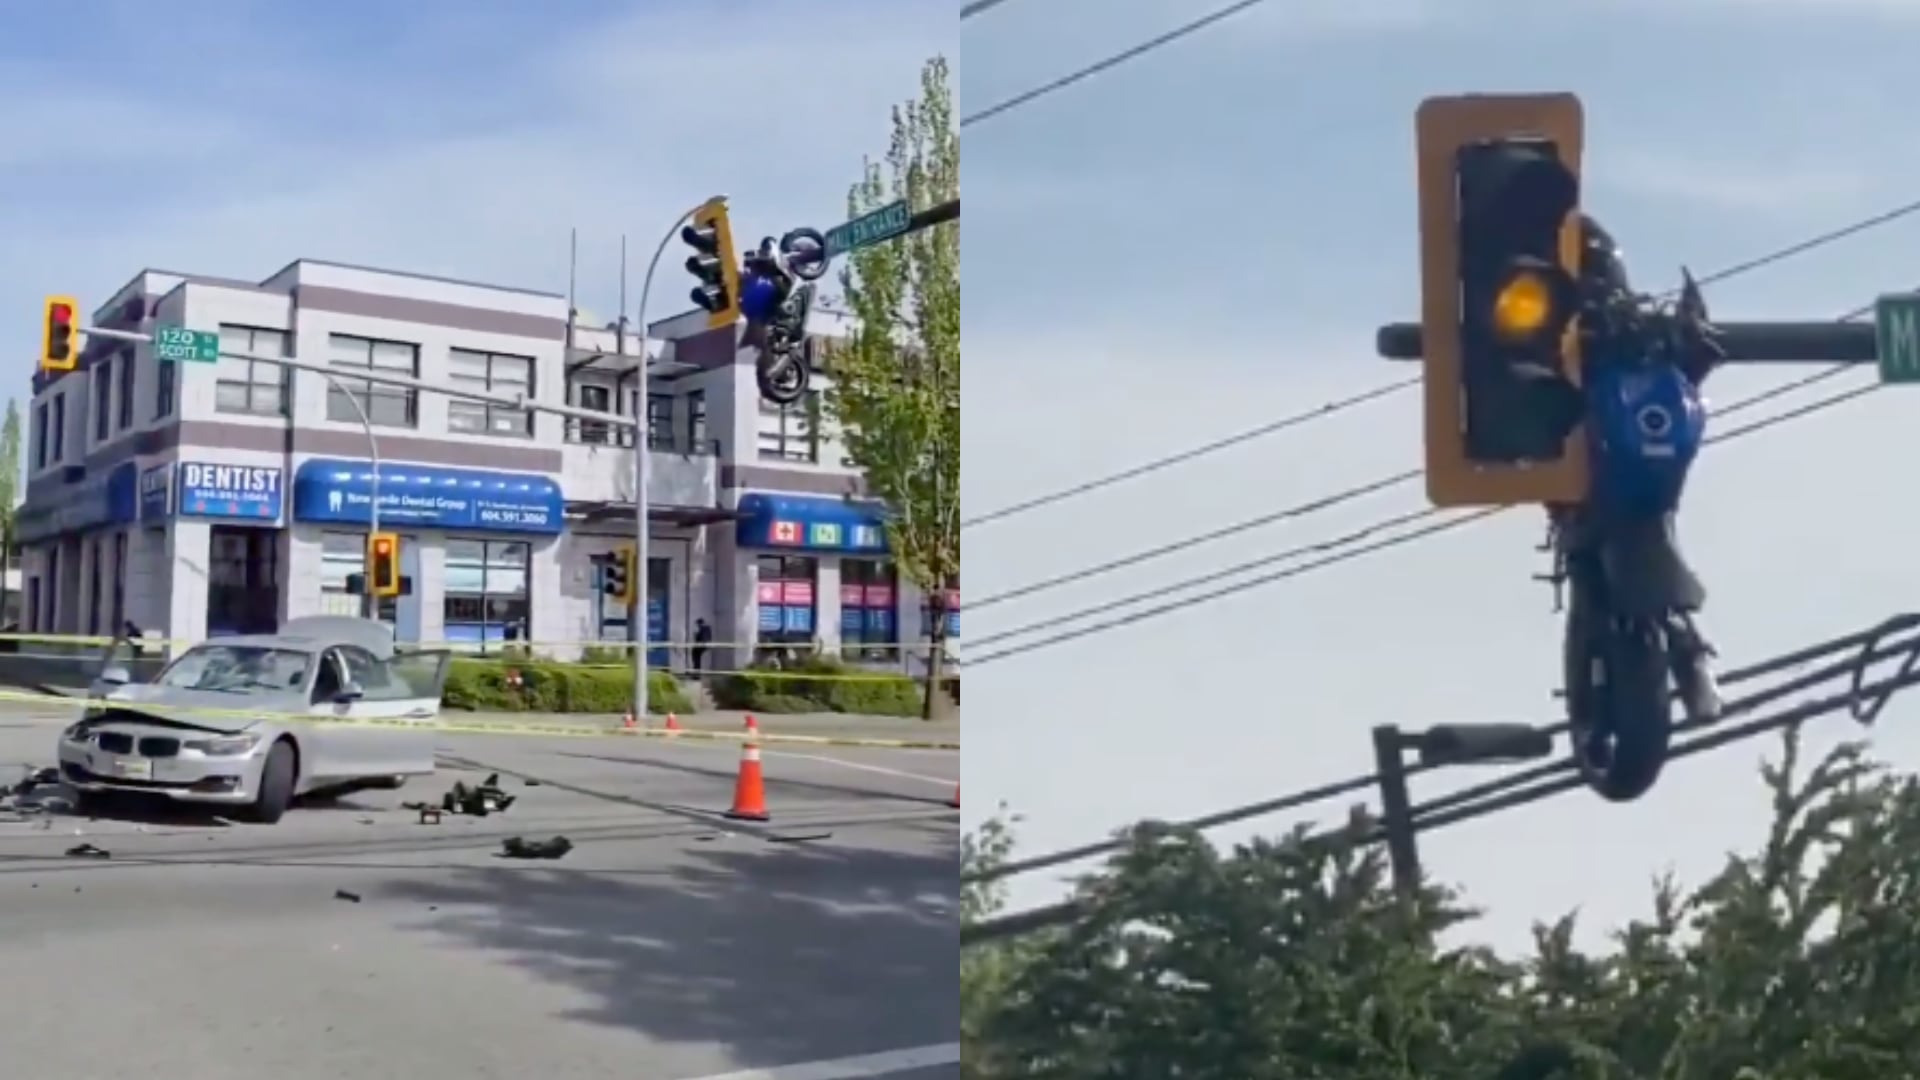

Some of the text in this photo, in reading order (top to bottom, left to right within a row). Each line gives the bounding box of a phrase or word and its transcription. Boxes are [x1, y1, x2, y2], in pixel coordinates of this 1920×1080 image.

[854, 204, 904, 244] ENTRANCE
[162, 330, 194, 344] 120
[159, 343, 197, 358] SCOTT
[185, 465, 278, 492] DENTIST
[402, 494, 435, 507] Dental
[437, 497, 467, 510] Group
